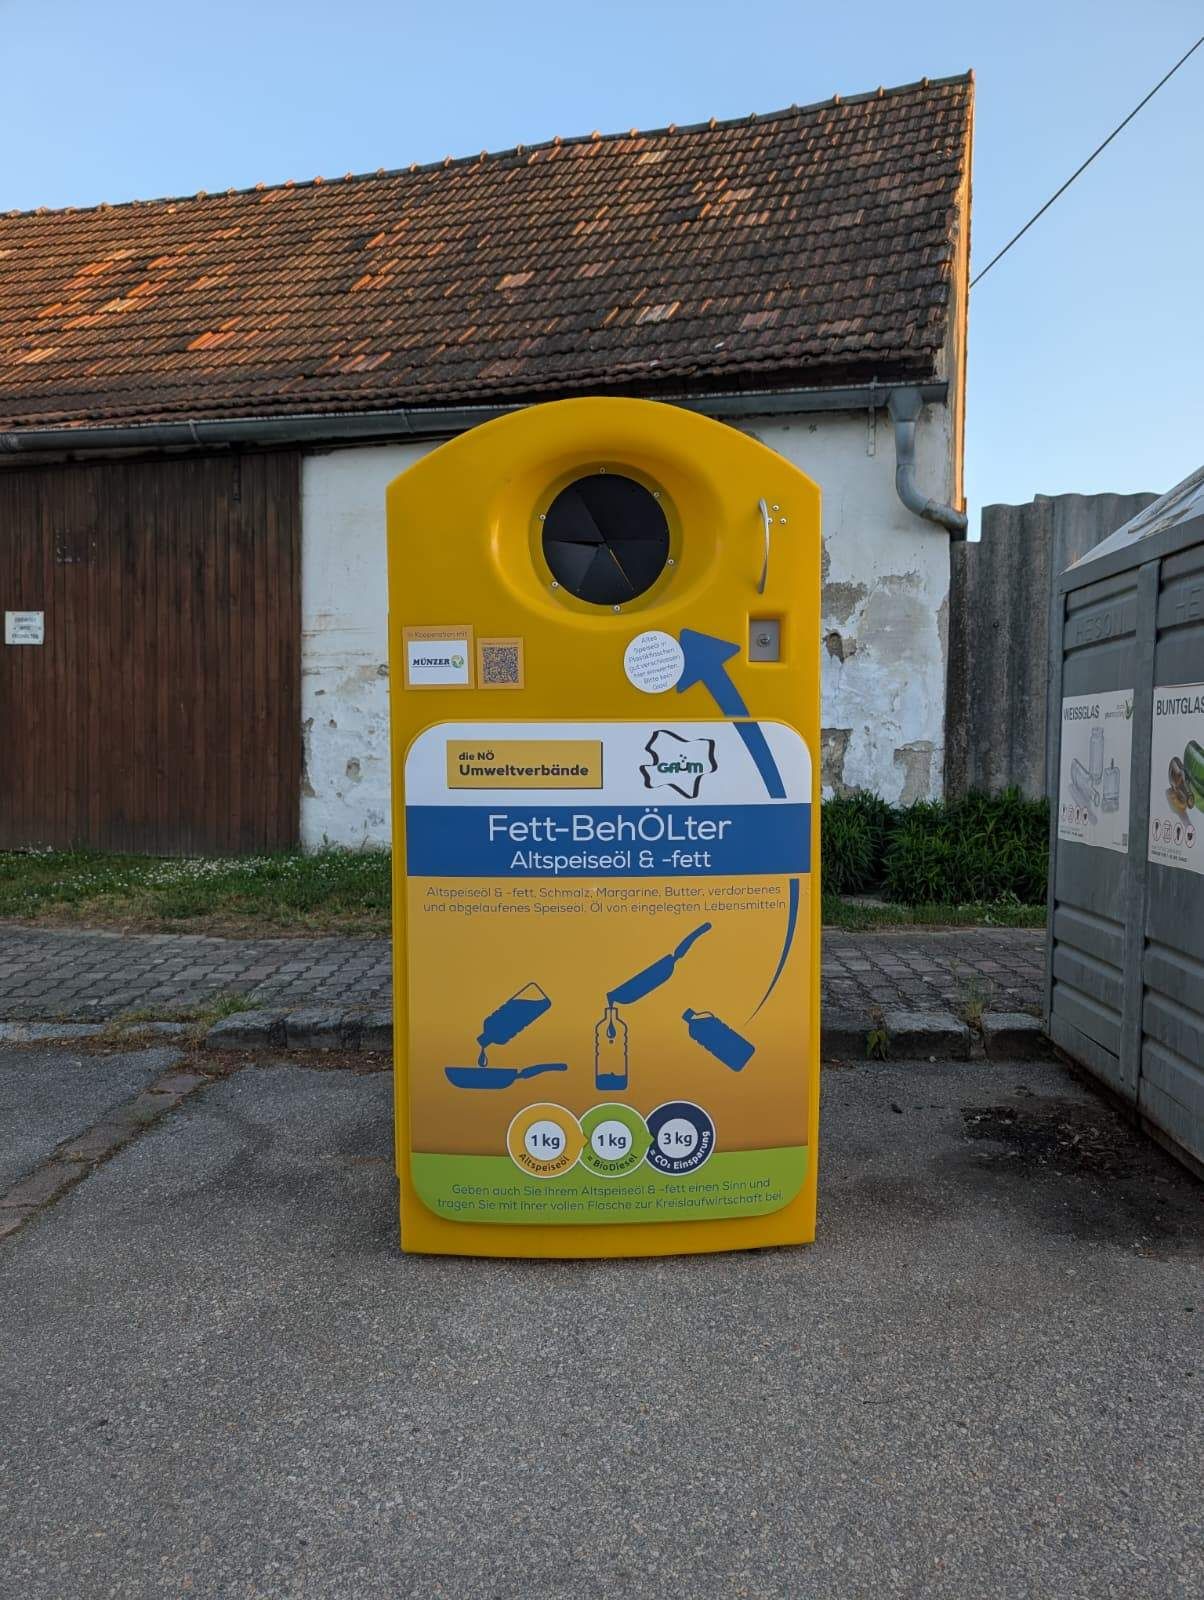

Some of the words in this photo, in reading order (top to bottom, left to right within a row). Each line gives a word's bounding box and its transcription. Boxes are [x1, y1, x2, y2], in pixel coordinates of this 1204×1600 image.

[415, 631, 455, 639] Kooperation
[412, 657, 450, 666] MÜNZER
[1063, 704, 1100, 720] WEISSGLAS
[459, 752, 475, 760] die
[477, 750, 495, 761] NÖ
[459, 764, 589, 776] Umweltverbände
[488, 807, 732, 842] Fett-BehÖLter
[510, 850, 631, 875] Altspeiseöl
[638, 850, 655, 868] &
[661, 849, 712, 868] -fett
[426, 886, 491, 900] Altspeiseöl
[494, 888, 503, 897] &
[539, 886, 593, 899] Schmalz,
[595, 886, 661, 900] Margarine,
[664, 886, 705, 897] Butter,
[708, 885, 781, 897] verdorbenes
[423, 903, 446, 913] und
[449, 902, 530, 915] abgelaufenes
[590, 901, 603, 913] Öl
[607, 904, 626, 913] von
[631, 902, 700, 915] eingelegten
[704, 900, 786, 911] Lebensmitteln
[530, 1134, 537, 1147] 1
[542, 1133, 560, 1149] kg
[597, 1134, 604, 1147] 1
[609, 1133, 627, 1149] kg
[663, 1132, 672, 1145] 3
[675, 1131, 692, 1148] kg
[673, 1130, 711, 1170] Einsparung
[518, 1153, 571, 1172] Altspeiseöl
[592, 1153, 638, 1171] BioDiesel
[451, 1184, 490, 1196] Geben
[492, 1186, 521, 1196] auch
[523, 1186, 542, 1197] Sie
[543, 1186, 578, 1197] Ihrem
[581, 1185, 643, 1197] Altspeiseöl
[647, 1185, 656, 1194] &
[660, 1183, 686, 1193] -fett
[688, 1183, 720, 1193] einen
[722, 1180, 748, 1191] Sinn
[749, 1178, 771, 1188] und
[437, 1198, 476, 1211] tragen
[478, 1199, 496, 1210] Sie
[501, 1200, 519, 1210] mit
[520, 1200, 548, 1210] Ihrer
[551, 1200, 585, 1210] vollen
[588, 1199, 632, 1210] Flasche
[635, 1199, 652, 1209] zur
[656, 1195, 763, 1208] Kreislaufwirtschaft
